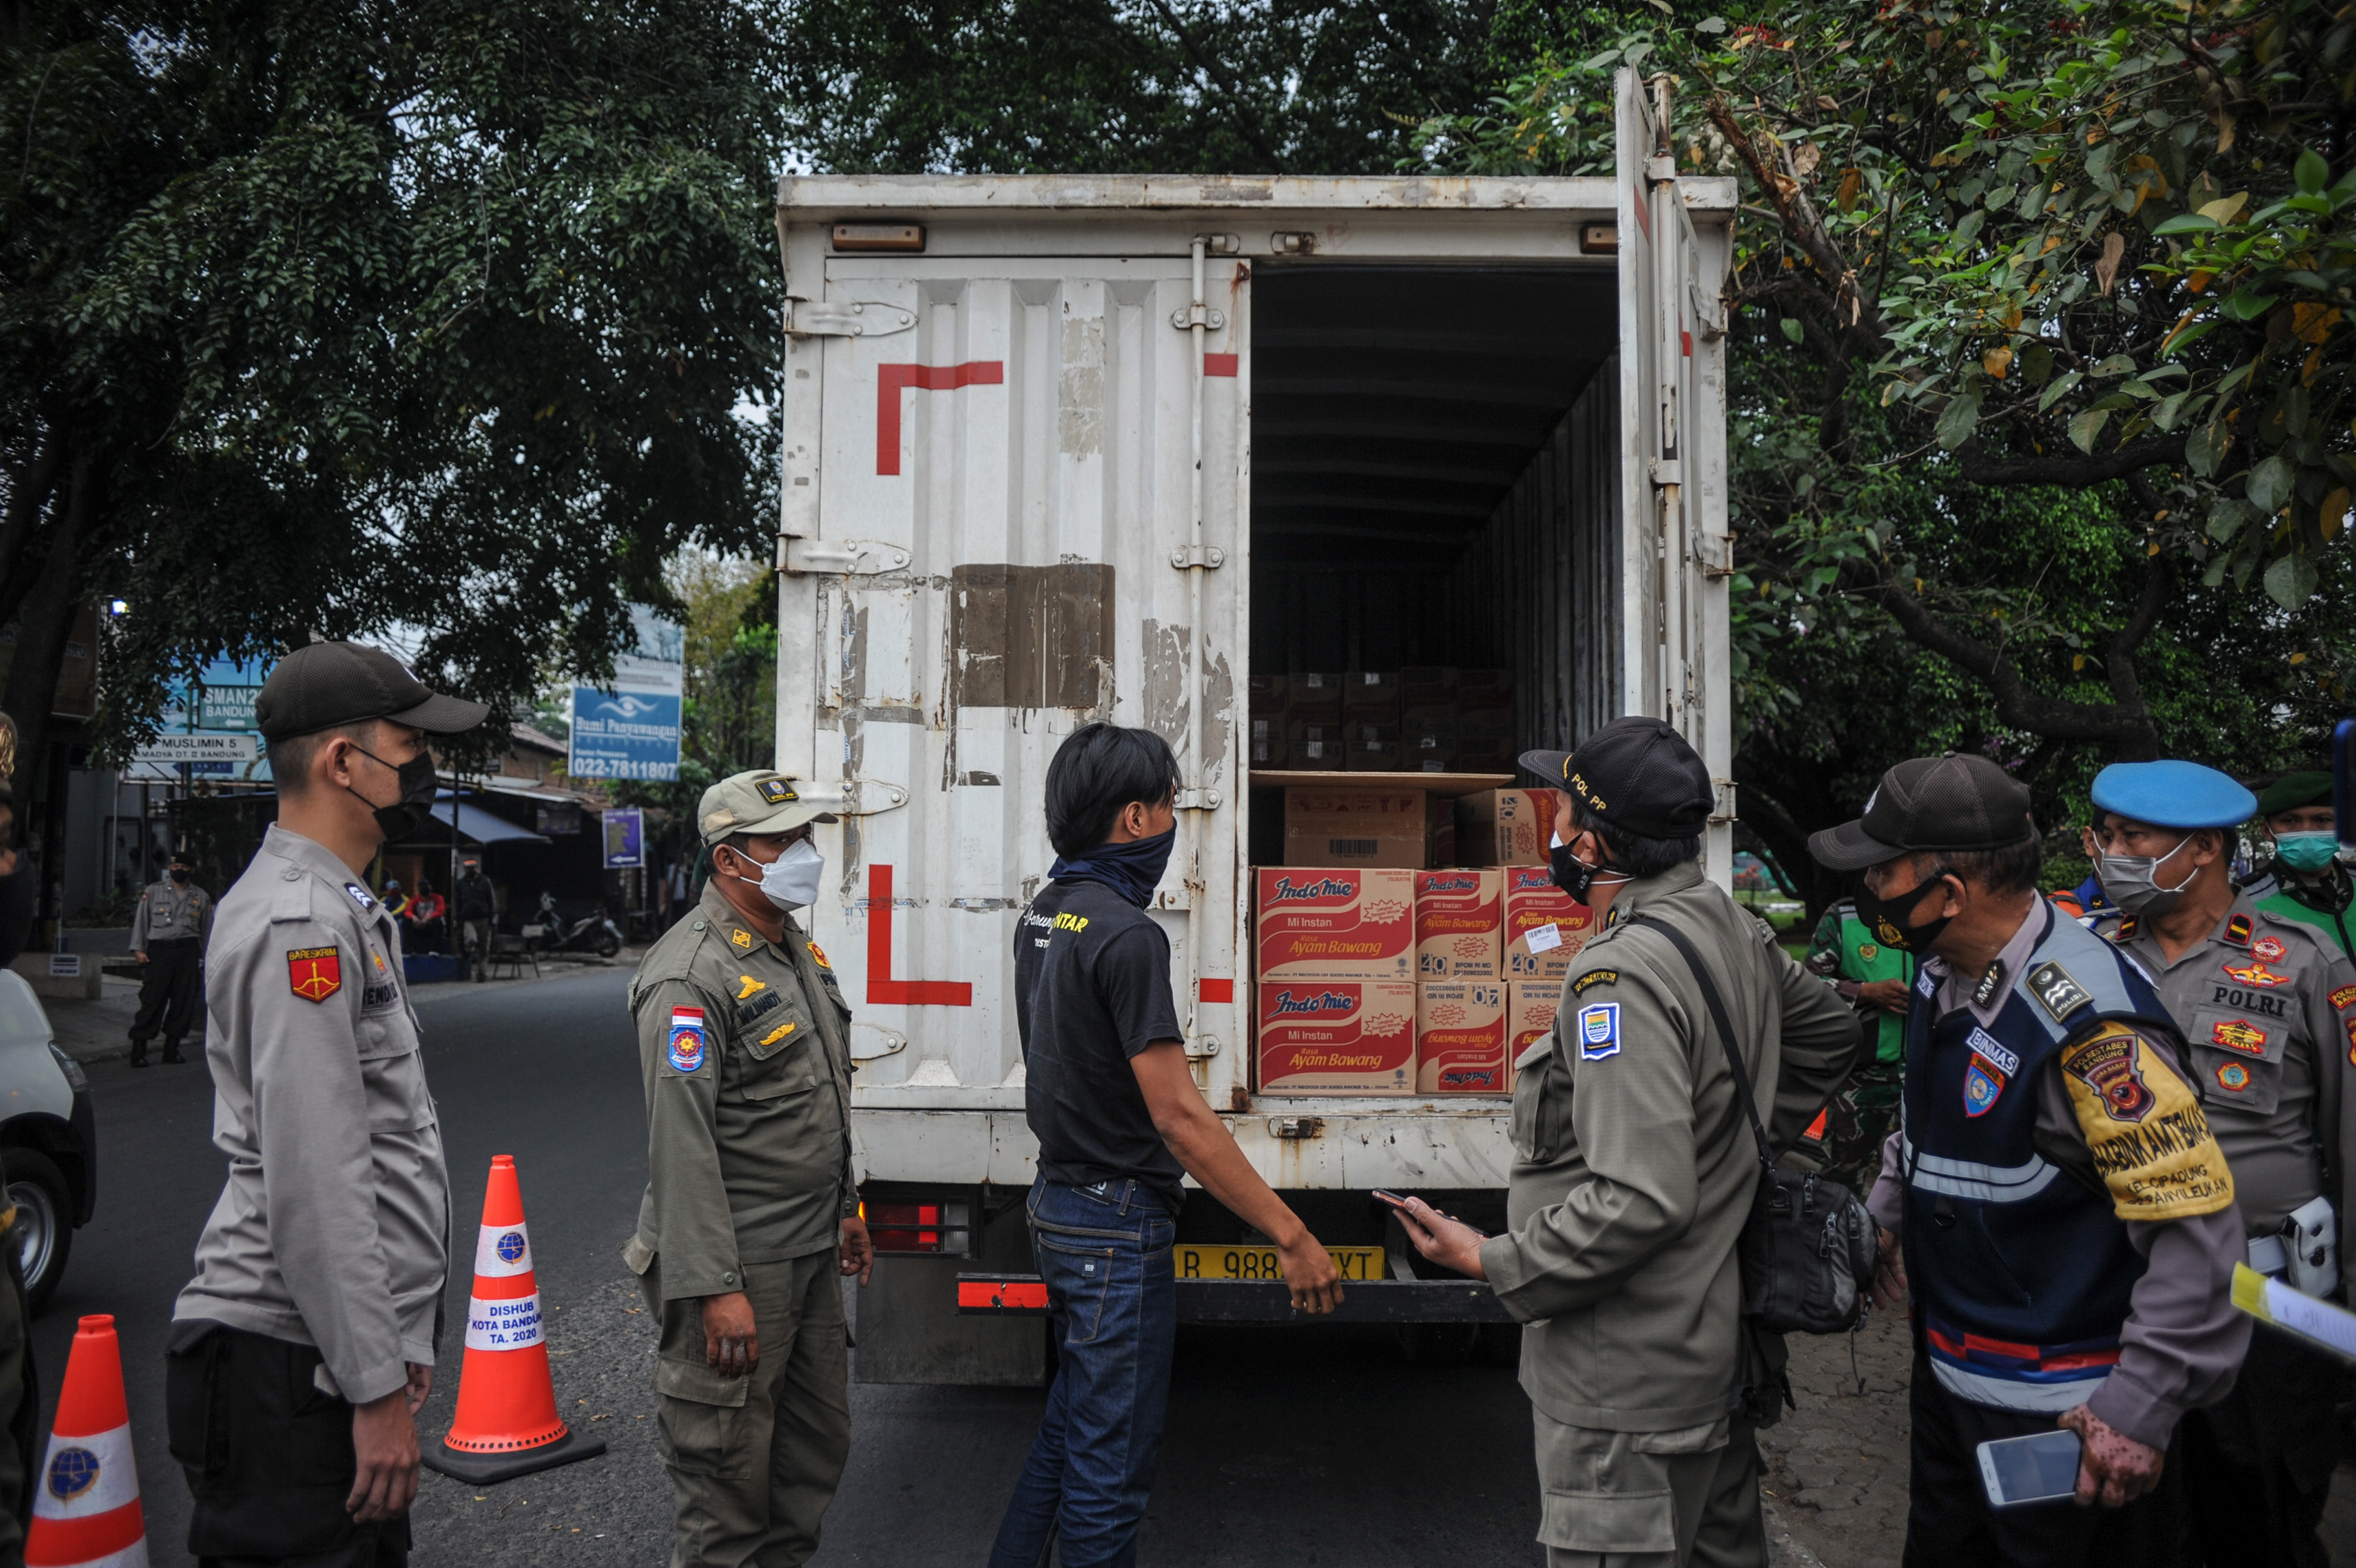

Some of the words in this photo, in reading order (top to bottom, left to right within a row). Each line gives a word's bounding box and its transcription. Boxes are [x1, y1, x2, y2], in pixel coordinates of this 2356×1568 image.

[206, 706, 257, 717] BANDUN
[576, 716, 605, 732] Bumi
[162, 738, 224, 749] MUSLIMIN
[229, 739, 237, 748] 5
[574, 757, 676, 779] 022-7811807
[1571, 773, 1589, 796] POL
[1590, 795, 1607, 810] PP
[1288, 918, 1299, 927] Mi
[1302, 918, 1332, 927] Instan
[1424, 918, 1451, 930] Ayam
[1452, 918, 1491, 930] Bawang
[1516, 915, 1544, 928] Ayam
[1545, 915, 1584, 928] Bawang
[289, 948, 337, 961] BARESKRIM
[1289, 941, 1326, 957] Ayam
[1328, 941, 1382, 956] Bawang
[2056, 993, 2083, 1013] POLISI
[2212, 987, 2286, 1017] POLRI
[1288, 1031, 1300, 1040] Mi
[1302, 1031, 1333, 1040] Instan
[1428, 1033, 1467, 1044] Bawang
[1468, 1033, 1496, 1044] Ayam
[1973, 1032, 2015, 1071] BINMAS
[2073, 1041, 2128, 1069] POLRESTABES
[1289, 1053, 1326, 1070] Ayam
[1328, 1053, 1382, 1069] Bawang
[2083, 1050, 2124, 1070] BANDUNG
[1976, 1059, 1998, 1081] BINMAS
[2094, 1069, 2107, 1081] JAWA
[2107, 1062, 2126, 1073] BARAT
[2149, 1164, 2208, 1188] CIPADUNG
[489, 1301, 534, 1317] DISHUB
[472, 1320, 498, 1331] KOTA
[489, 1334, 509, 1344] TA.
[512, 1328, 537, 1343] 2020
